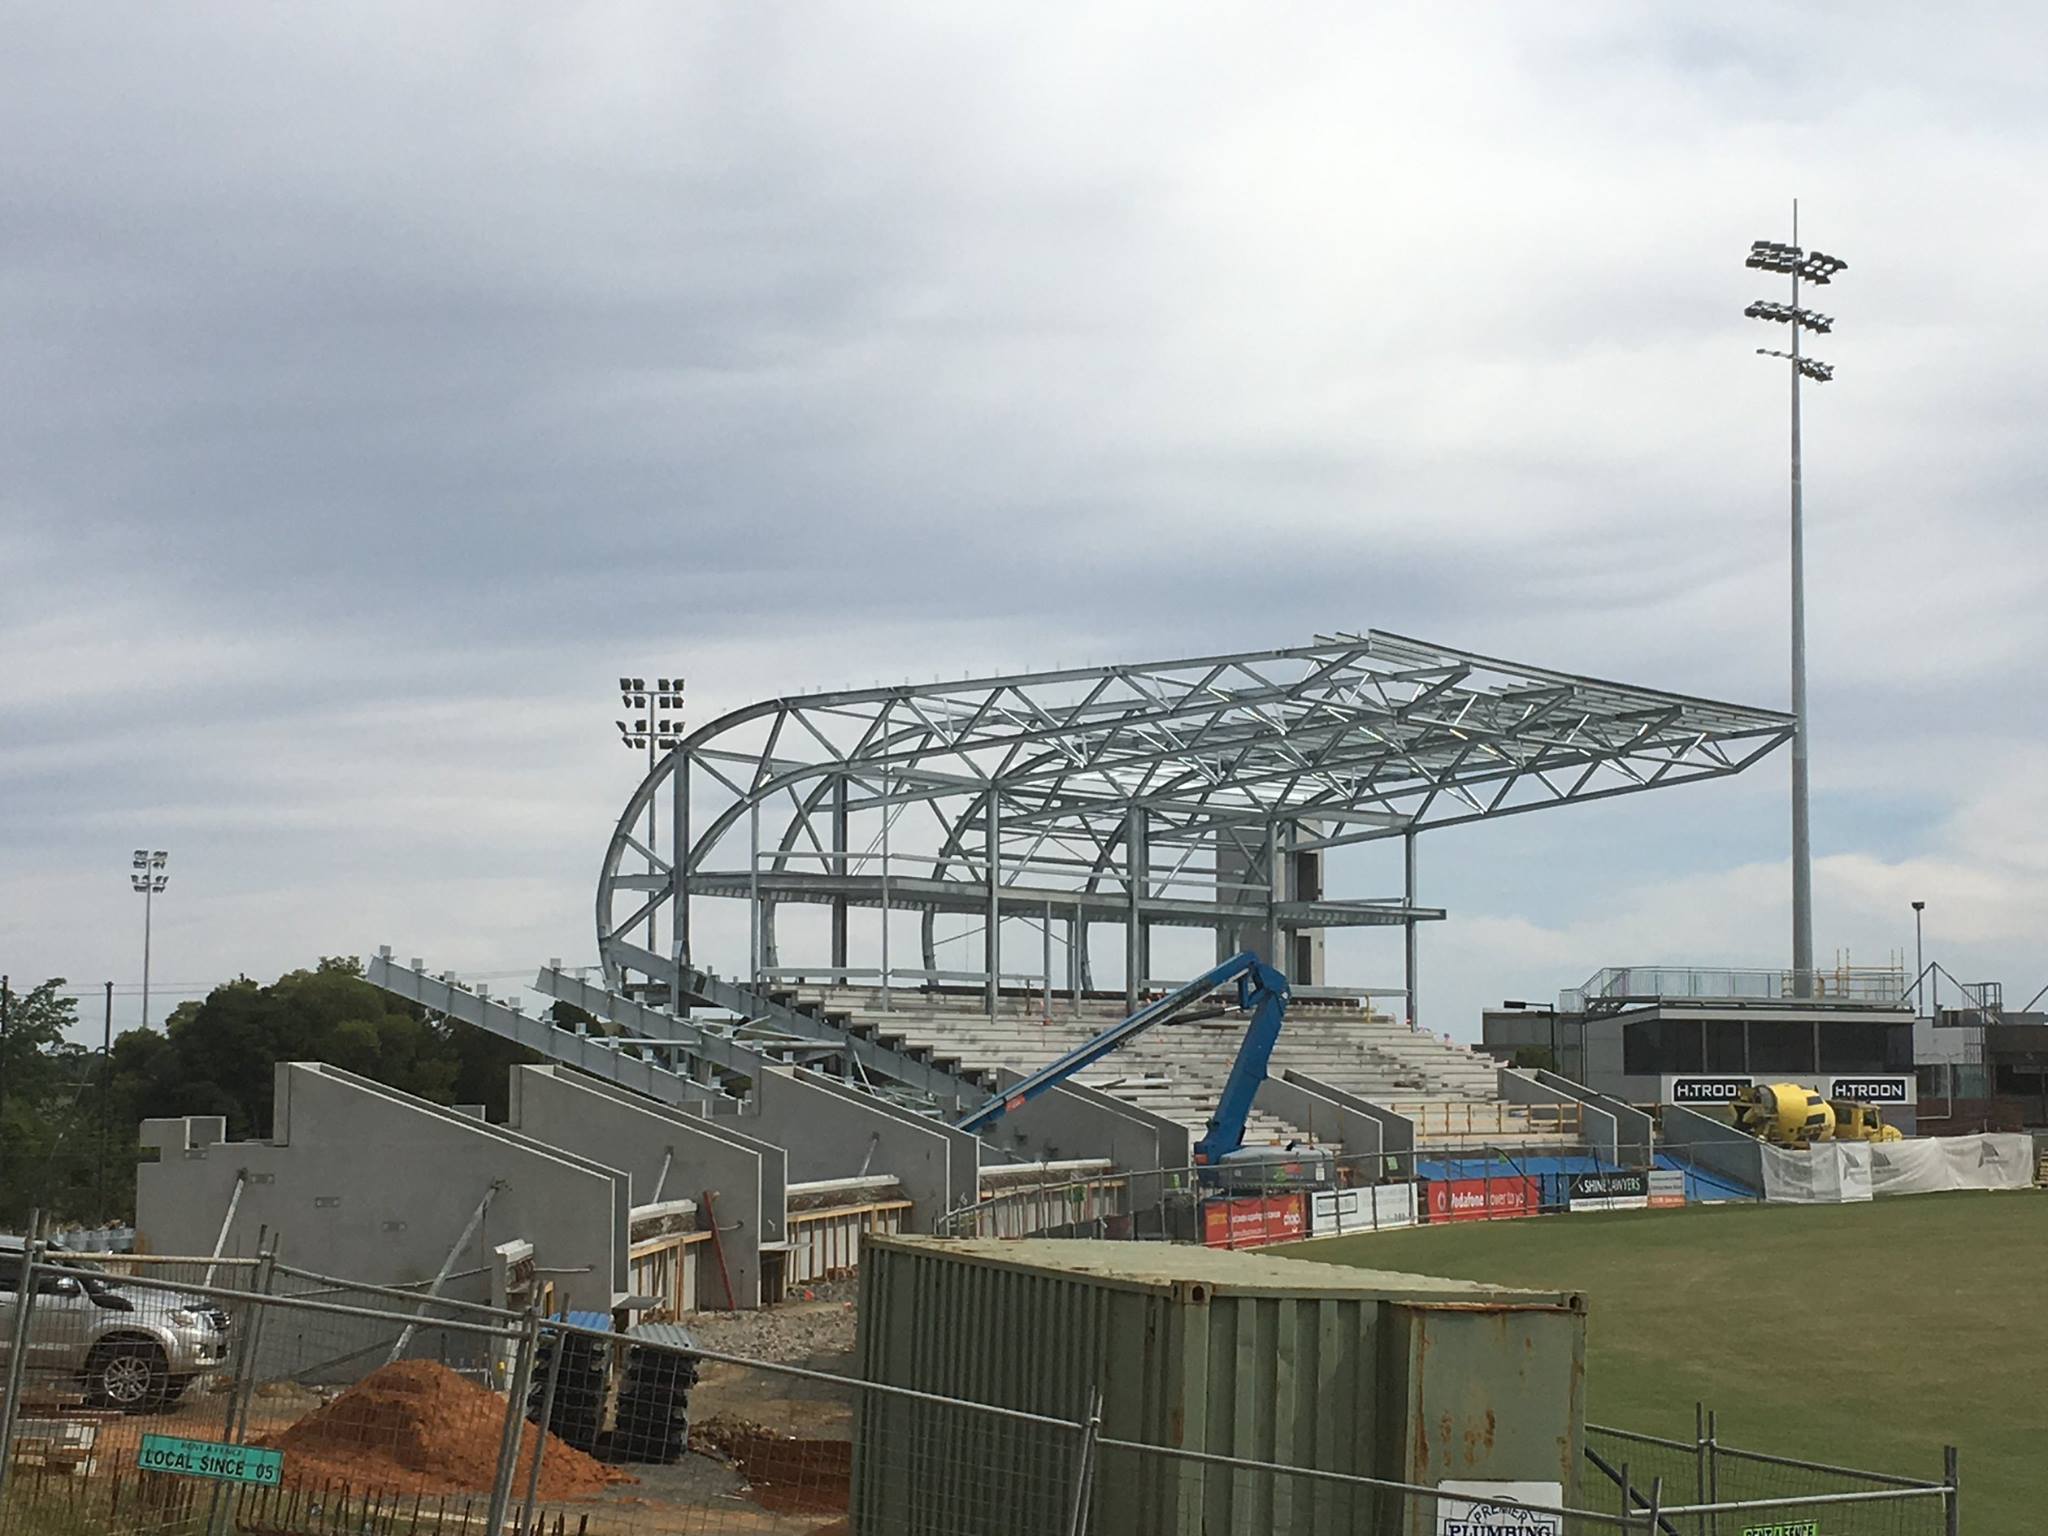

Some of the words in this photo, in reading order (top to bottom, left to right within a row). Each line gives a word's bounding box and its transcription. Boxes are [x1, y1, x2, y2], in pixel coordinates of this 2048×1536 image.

[1677, 1084, 1741, 1097] H.TROO
[1835, 1084, 1902, 1096] H.TROON
[144, 1450, 193, 1469] LOCAL
[200, 1455, 245, 1476] SINCE
[255, 1463, 274, 1480] 05
[1448, 1525, 1551, 1536] PLUMBING
